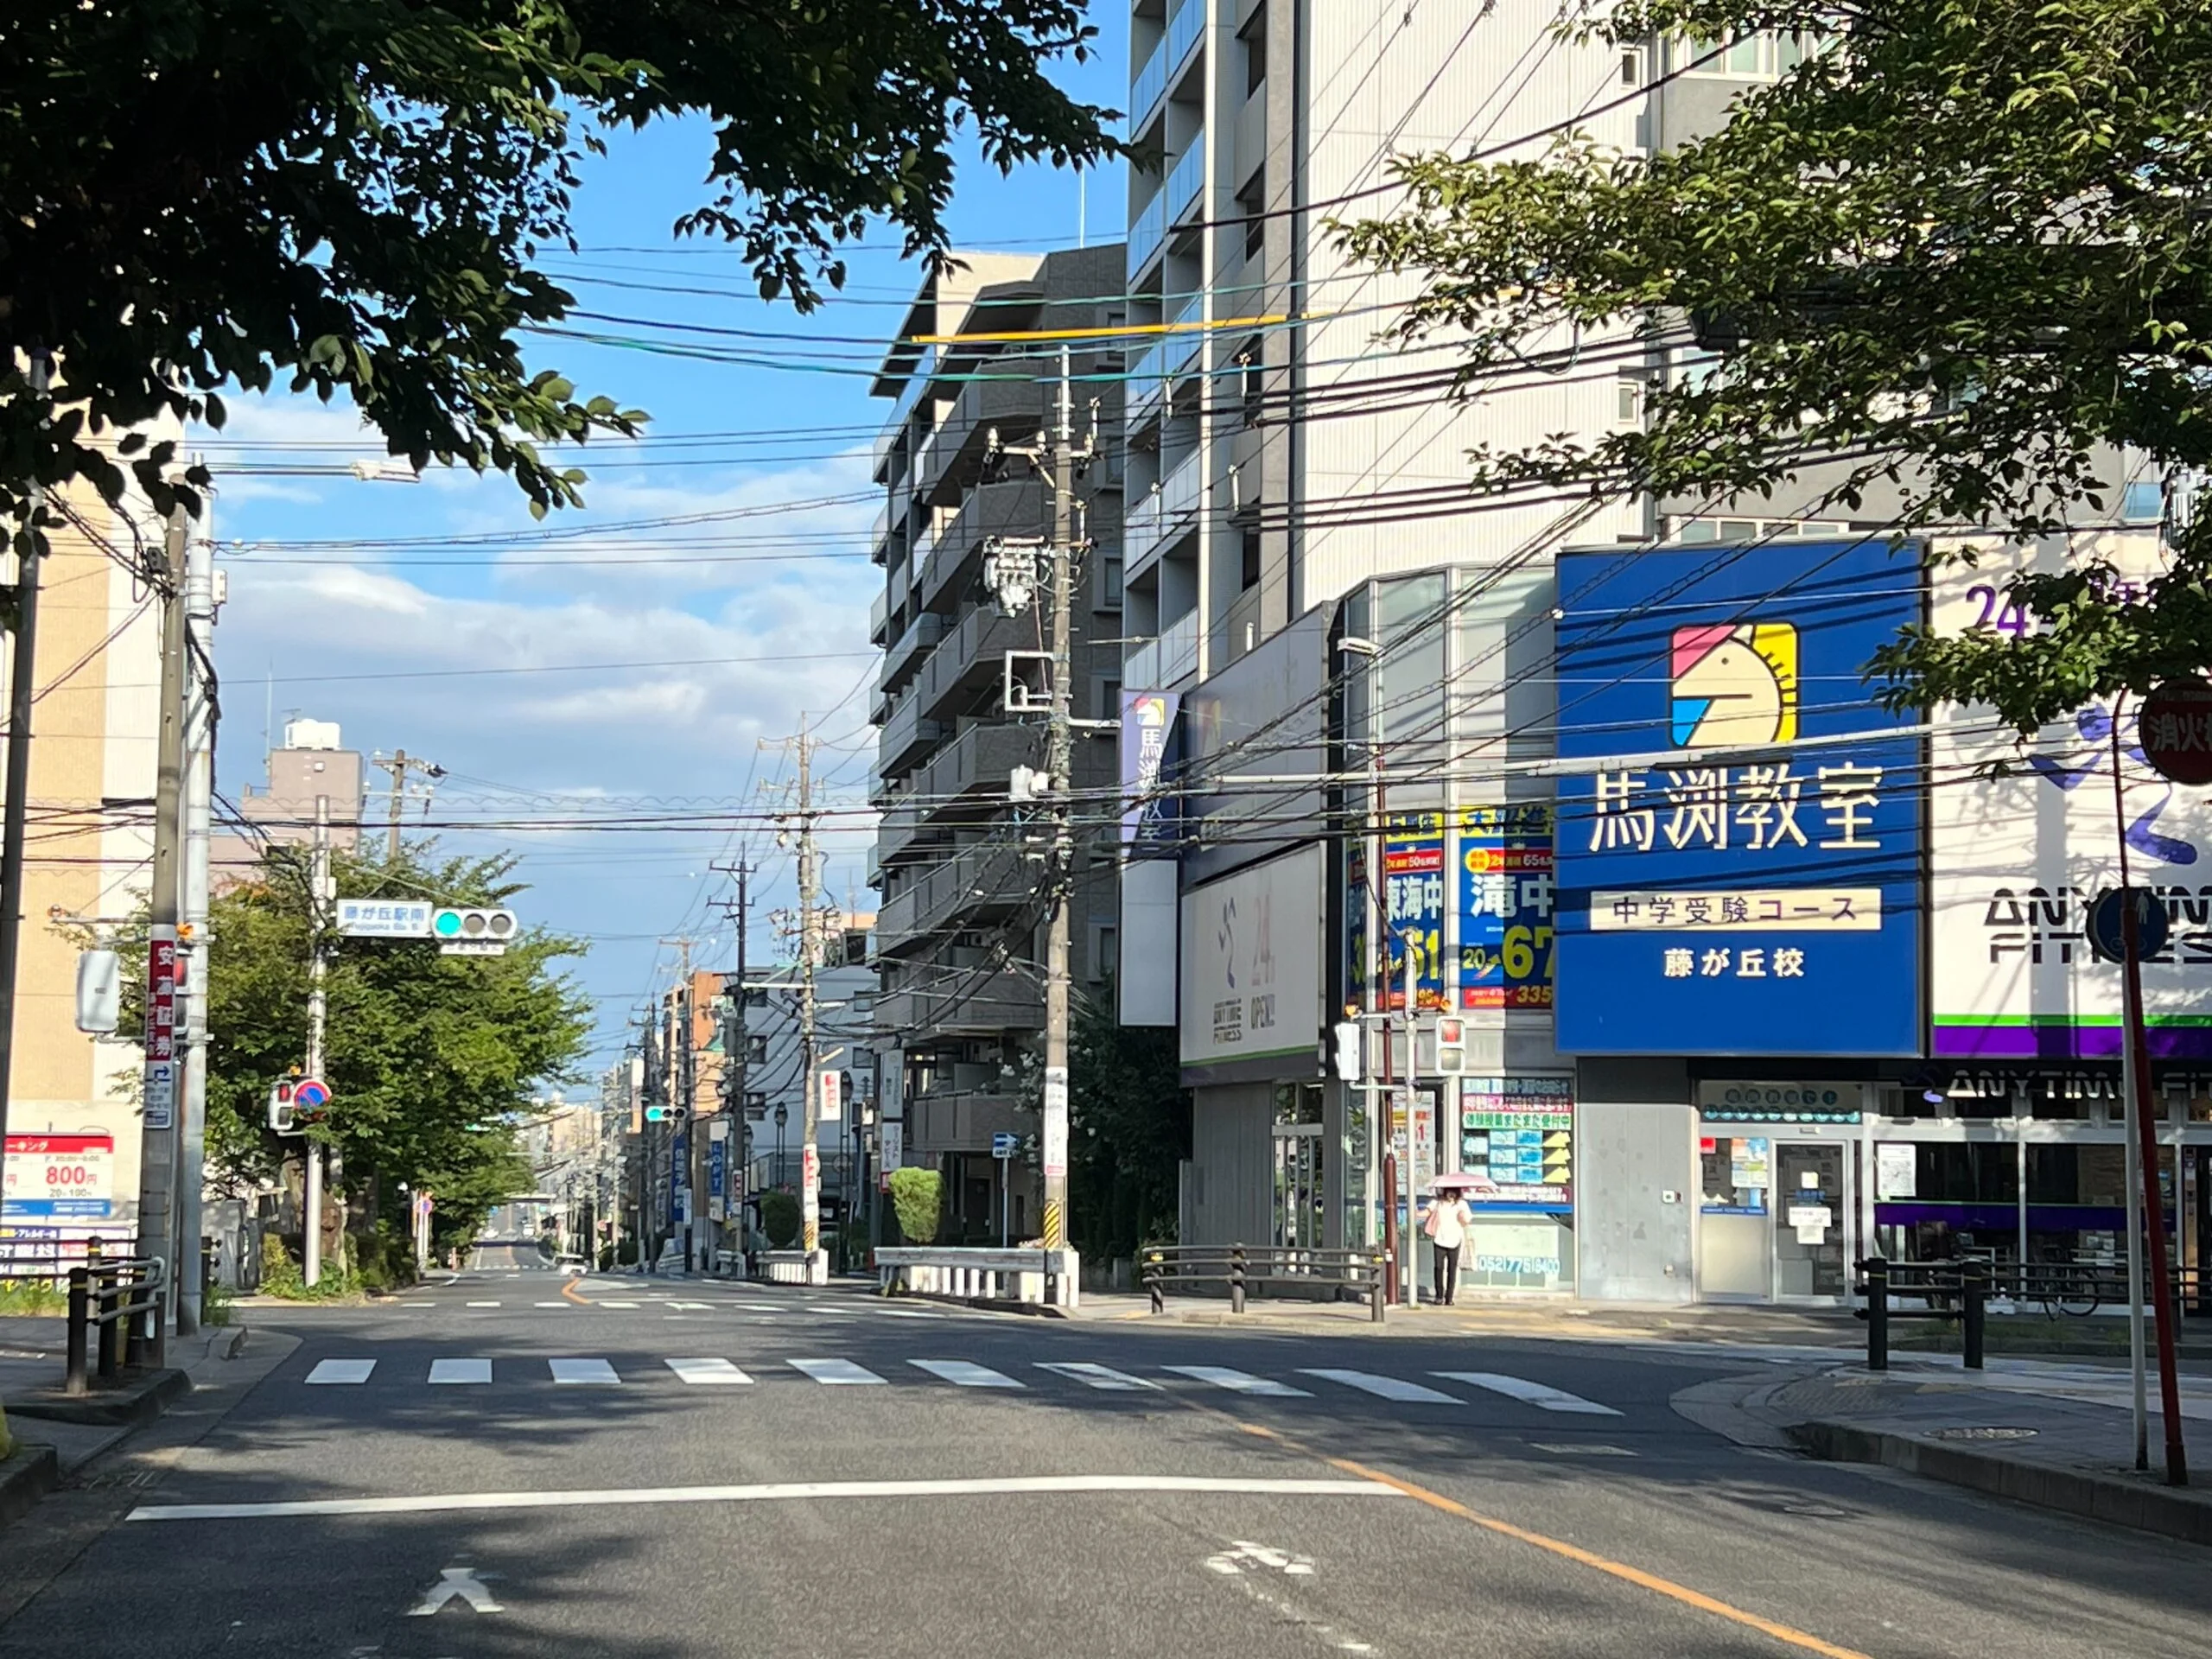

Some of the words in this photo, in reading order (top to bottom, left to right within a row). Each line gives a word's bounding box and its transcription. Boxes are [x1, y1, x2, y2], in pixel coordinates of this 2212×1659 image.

[1966, 584, 2031, 640] 24
[2148, 711, 2212, 753] 消火
[1589, 761, 1883, 851] 馬渕教室
[345, 906, 423, 922] 藤が丘駅南
[1387, 874, 1443, 921] 東海中
[1471, 874, 1553, 918] 滝中
[1613, 896, 1856, 924] 中学受験コース
[1462, 949, 1486, 969] 20
[1503, 925, 1553, 979] 67
[1664, 948, 1805, 977] 藤が丘校
[1947, 1070, 2123, 1099] ANYTIM
